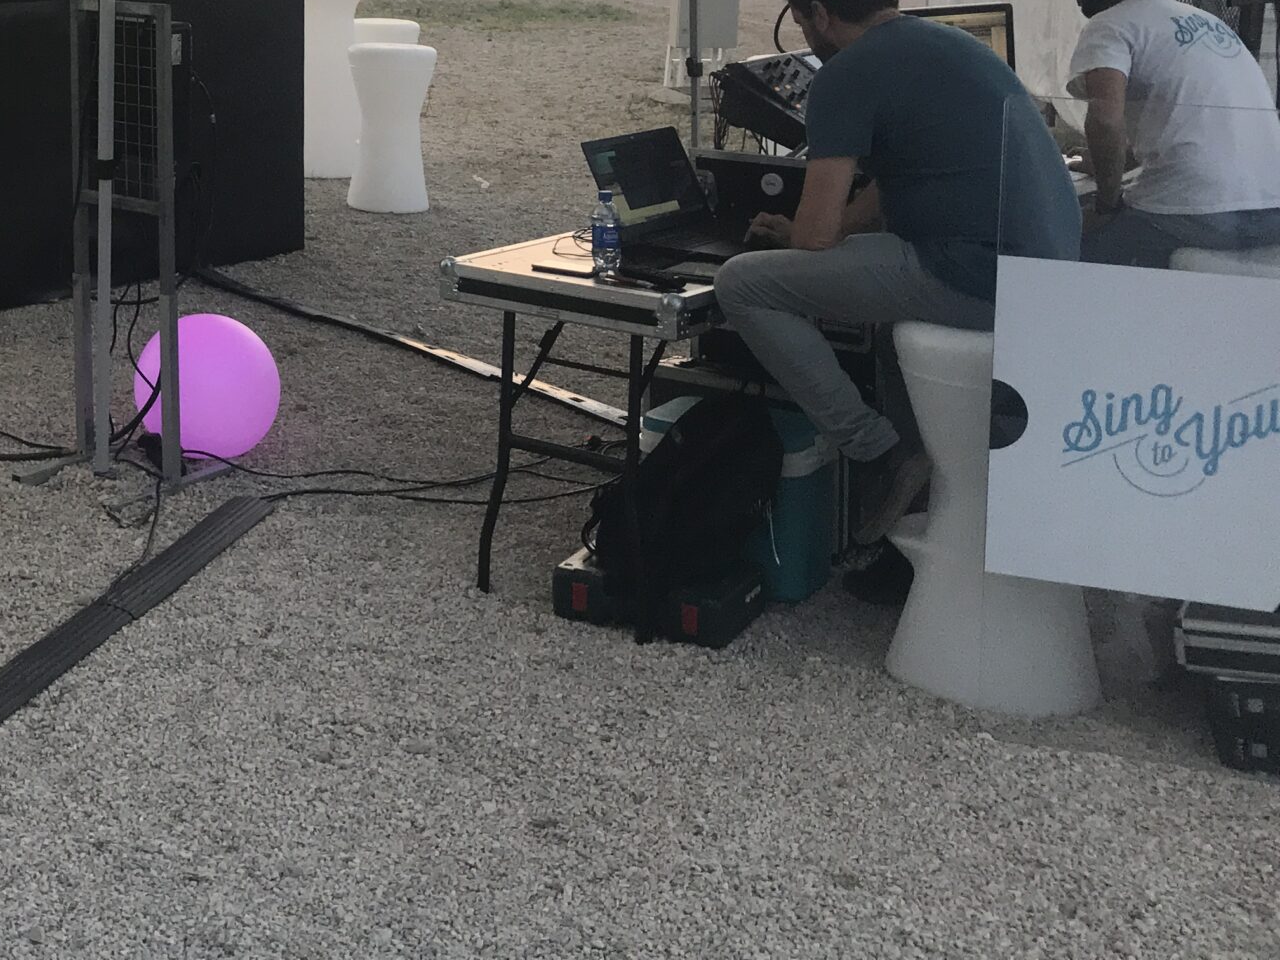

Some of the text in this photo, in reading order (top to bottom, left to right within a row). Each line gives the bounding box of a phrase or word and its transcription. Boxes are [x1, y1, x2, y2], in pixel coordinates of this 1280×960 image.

[1062, 383, 1280, 476] Sing to You
